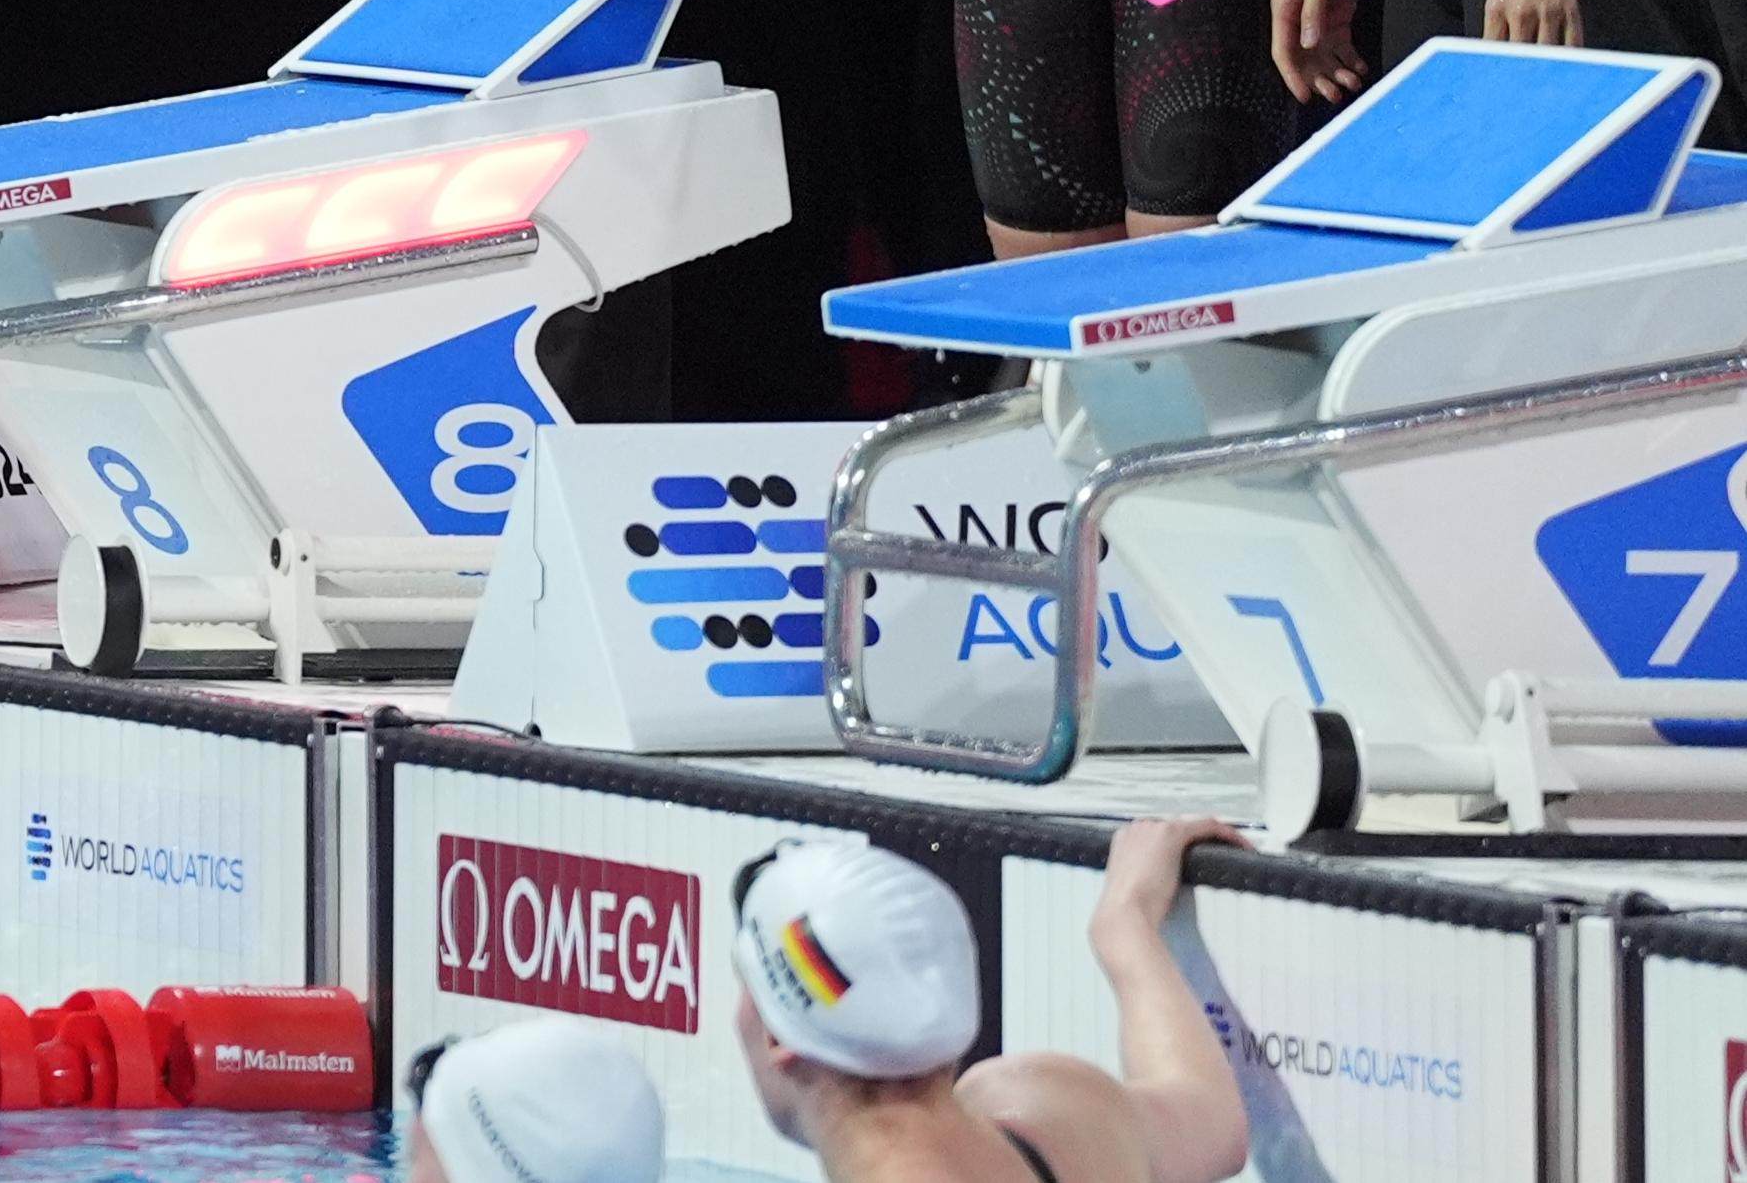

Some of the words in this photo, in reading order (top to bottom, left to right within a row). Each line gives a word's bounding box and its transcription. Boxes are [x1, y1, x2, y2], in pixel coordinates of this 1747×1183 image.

[1126, 305, 1220, 338] OMEGA
[88, 446, 189, 555] 8
[430, 403, 537, 513] 8
[1224, 594, 1325, 706] 7
[1625, 550, 1740, 666] 7
[503, 874, 698, 1008] OMEGA
[244, 1049, 355, 1074] Malmsten
